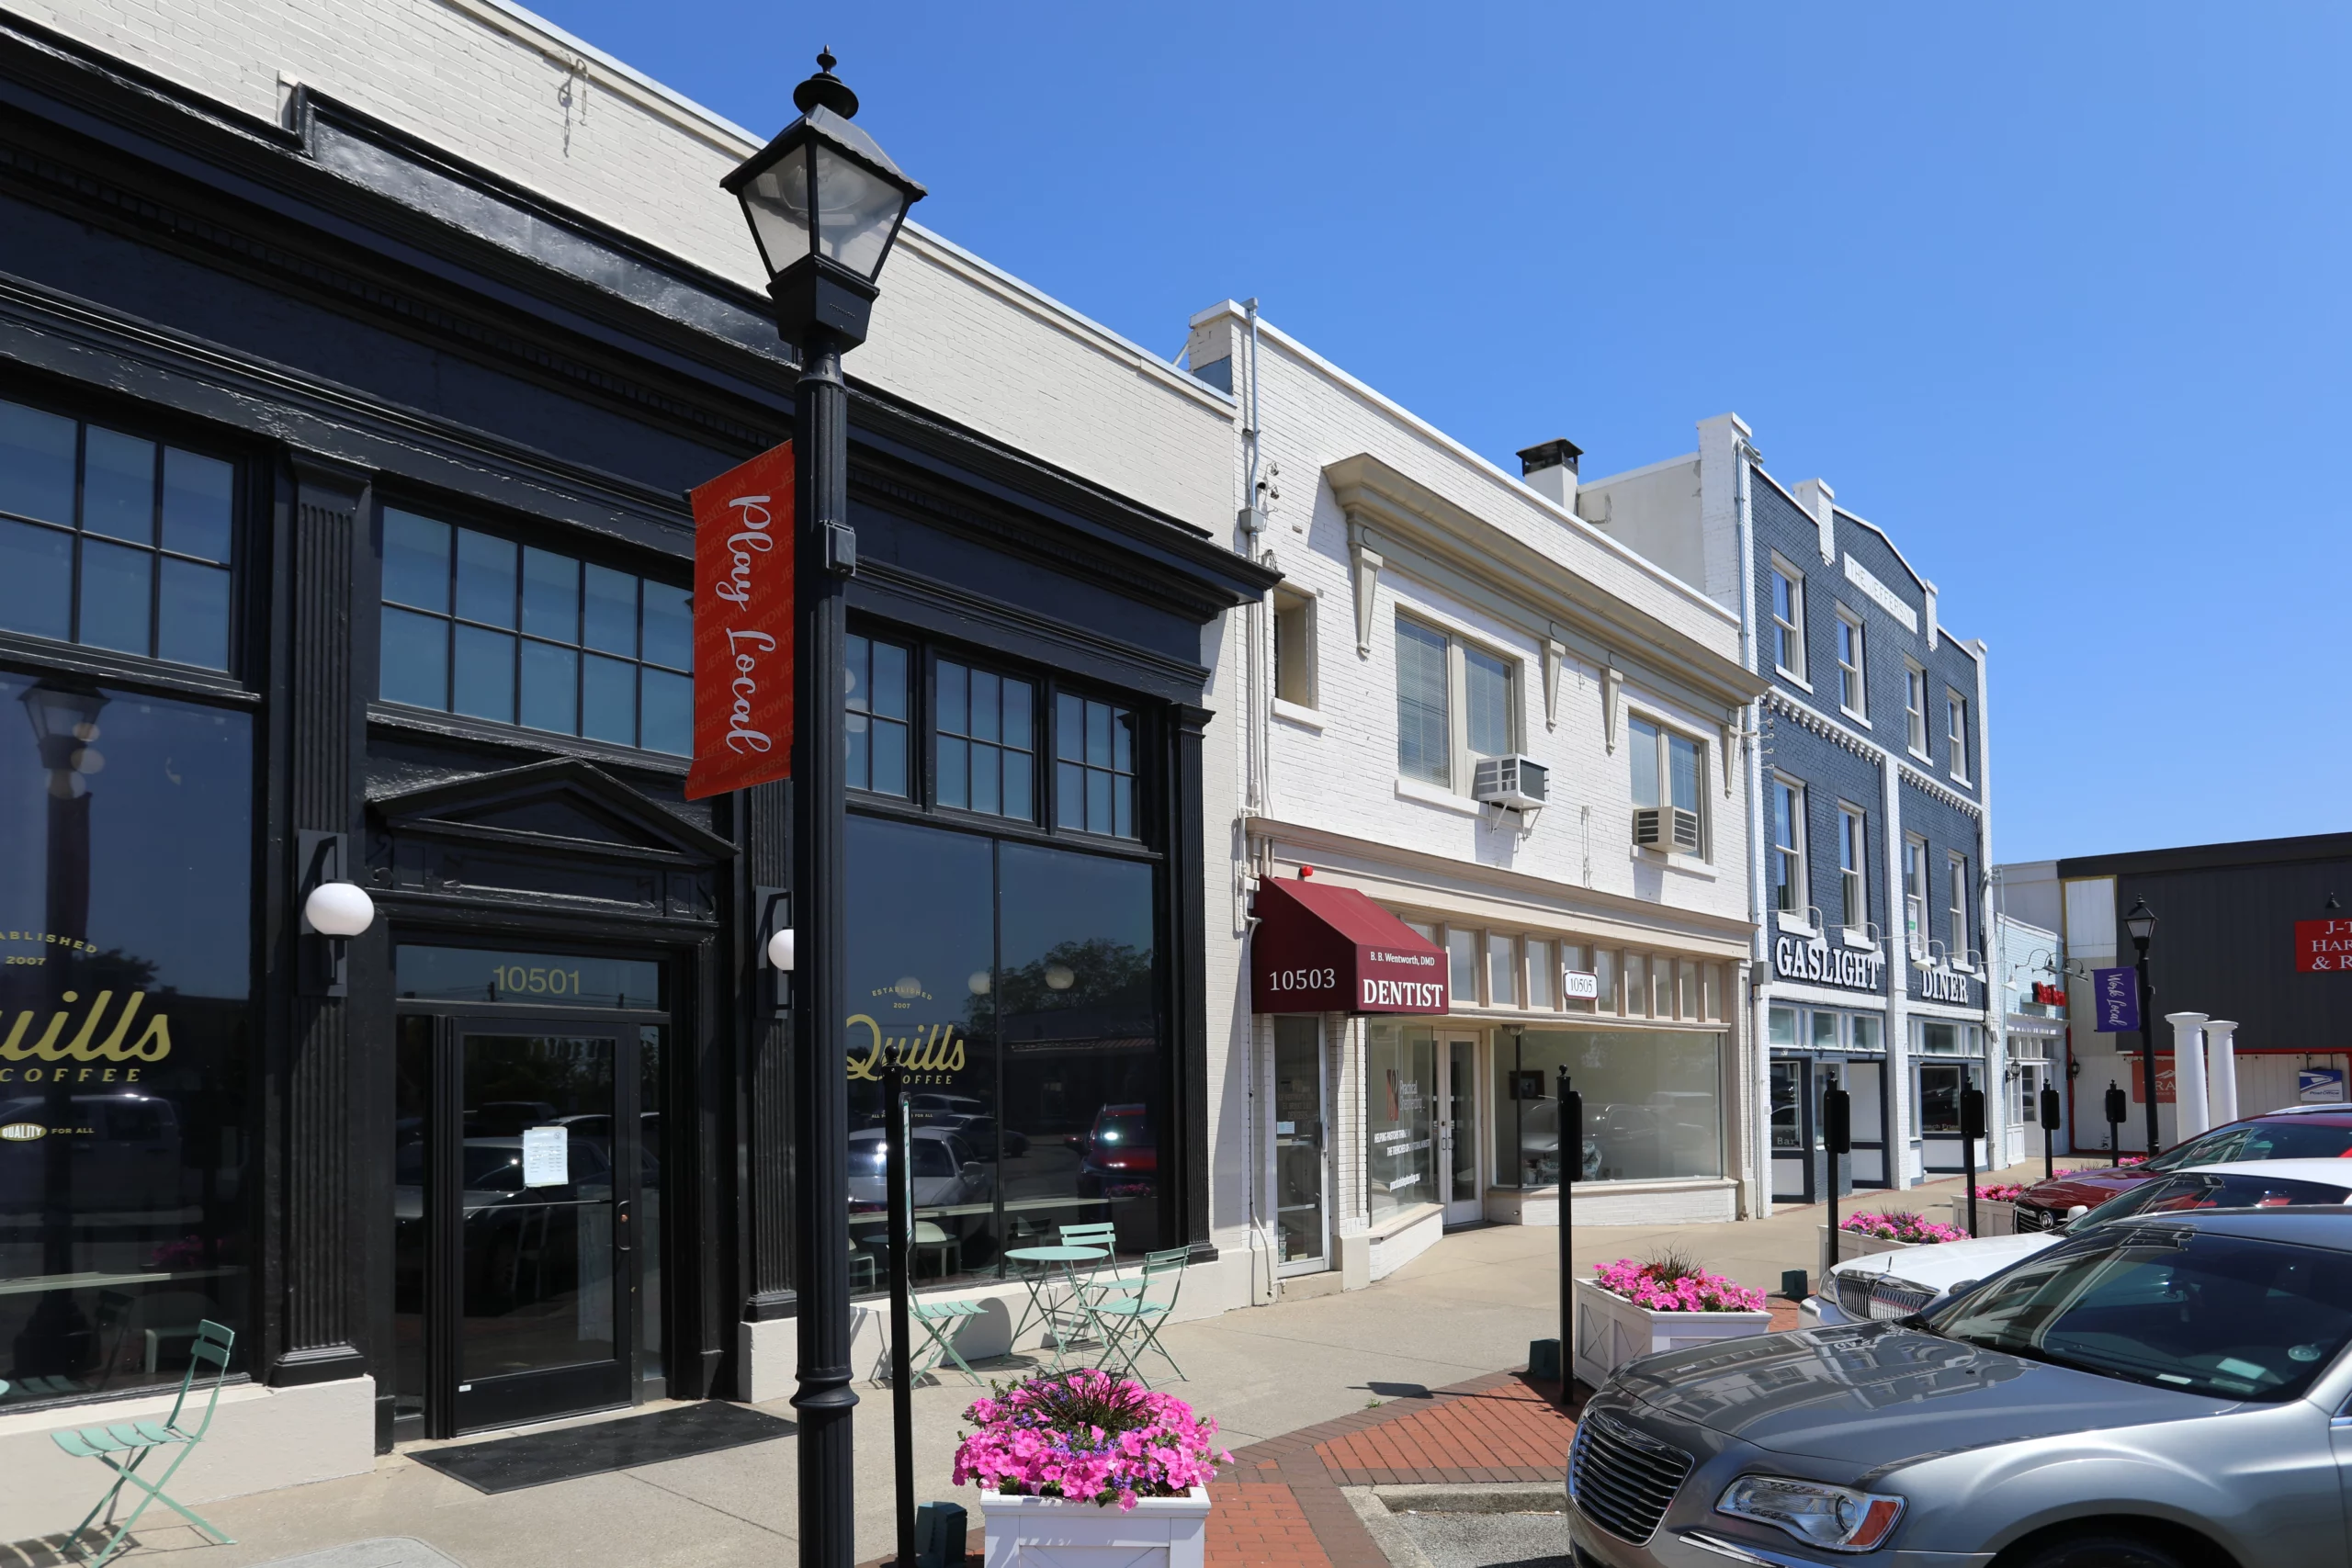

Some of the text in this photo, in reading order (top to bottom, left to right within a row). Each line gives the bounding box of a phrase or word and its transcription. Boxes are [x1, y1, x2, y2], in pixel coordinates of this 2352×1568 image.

[716, 495, 774, 613] Play
[1849, 559, 1914, 628] THE JEFFERSON
[725, 626, 776, 755] Local
[5, 955, 47, 966] 2007
[1370, 952, 1435, 966] B. B. Wentworth, DMD
[1776, 936, 1880, 989] GASLIGHT
[2312, 955, 2332, 970] &
[493, 964, 579, 995] 10501
[1269, 968, 1336, 991] 10503
[1570, 977, 1592, 993] 10505
[1922, 970, 1969, 1003] DINER
[871, 986, 933, 1000] ESTABLISHED
[1363, 978, 1443, 1008] DENTIST
[2107, 974, 2128, 1026] Work Local
[846, 1013, 966, 1082] Quills
[0, 1068, 141, 1082] COFFEE
[902, 1075, 952, 1085] OFFEE
[2, 1125, 42, 1139] QUALITY
[1777, 1136, 1795, 1145] Bar
